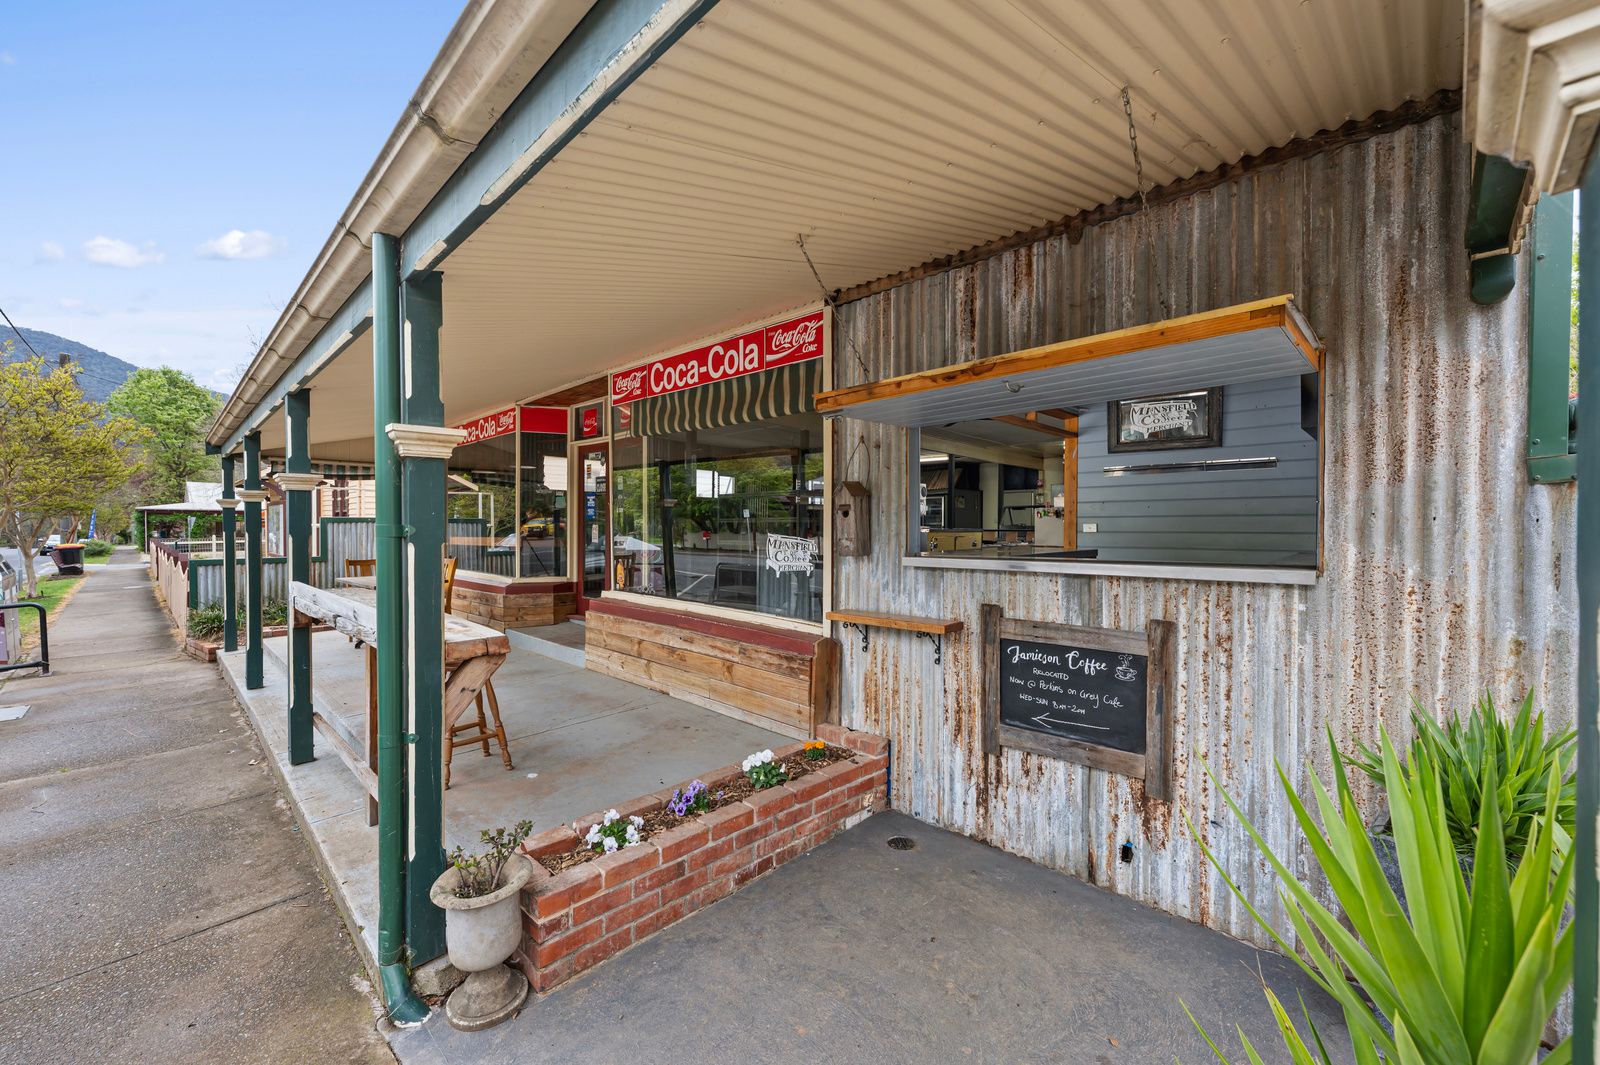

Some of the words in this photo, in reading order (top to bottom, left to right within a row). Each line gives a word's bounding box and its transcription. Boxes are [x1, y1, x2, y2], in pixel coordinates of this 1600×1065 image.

[771, 319, 818, 351] Coca-Cola
[650, 339, 759, 393] Coca-Cola
[1140, 411, 1184, 426] Coffee
[774, 550, 809, 563] Coffee
[1007, 645, 1061, 666] Jamieson
[1065, 650, 1108, 676] Coffee
[1032, 667, 1069, 681] RELOCATED
[1027, 680, 1036, 689] @
[1103, 694, 1124, 708] Cafe
